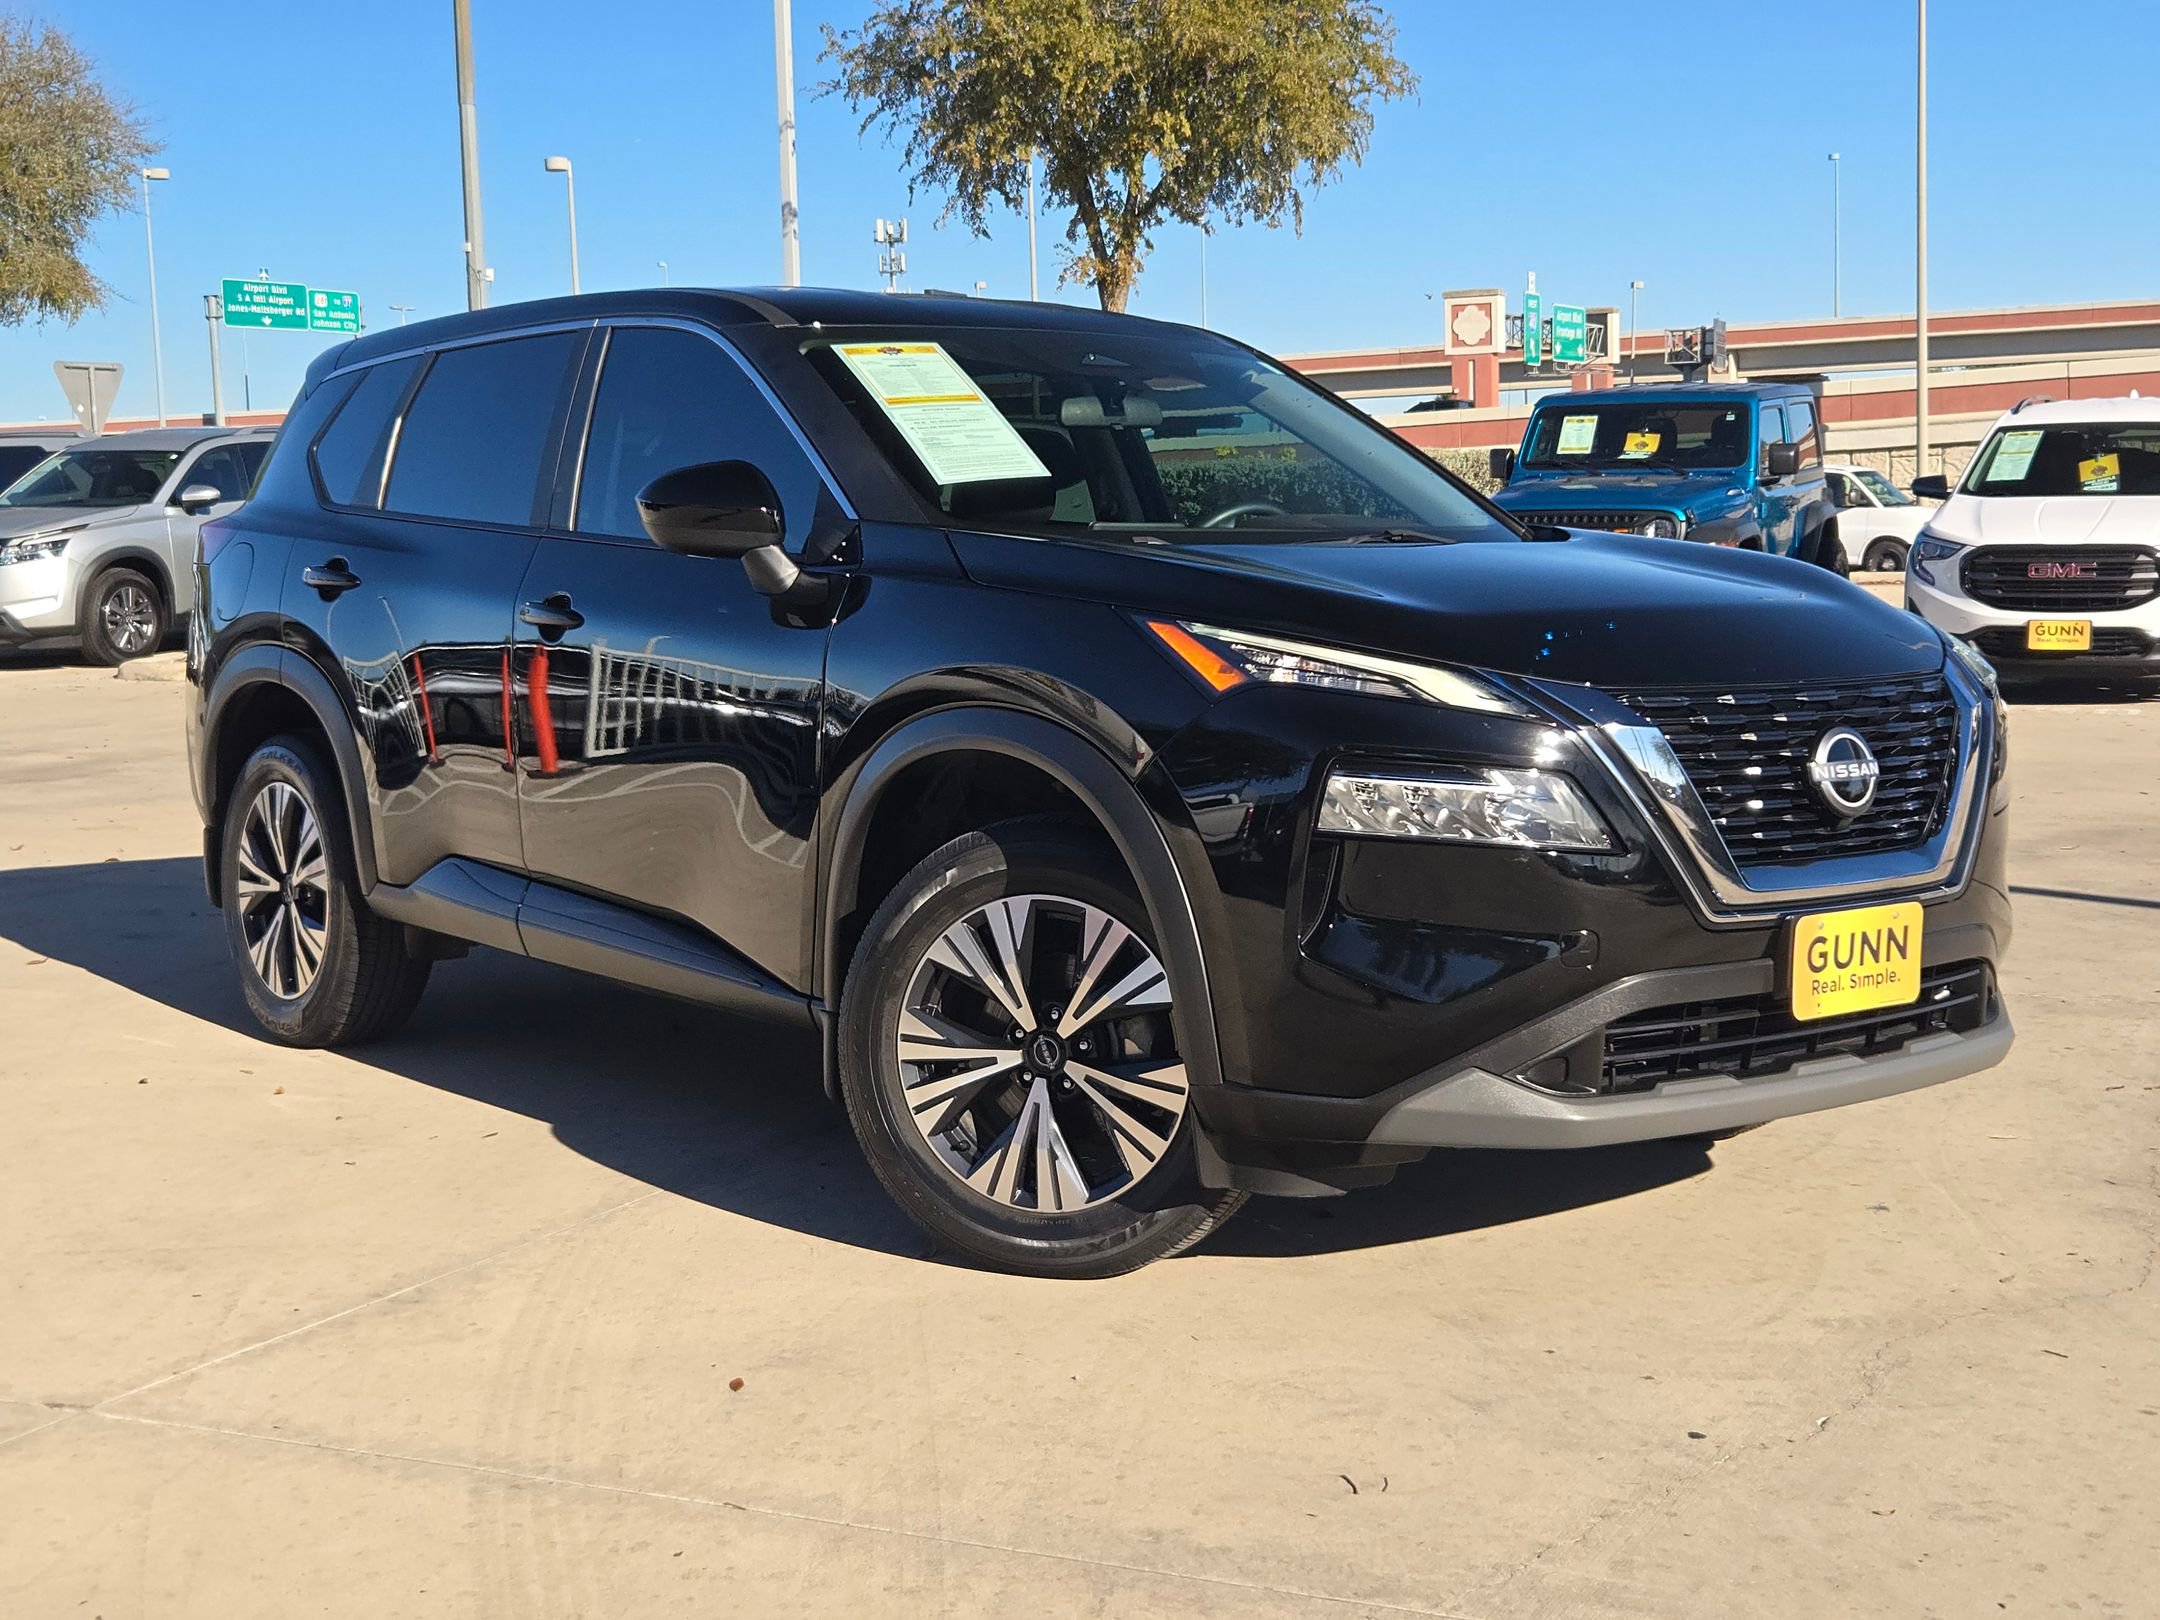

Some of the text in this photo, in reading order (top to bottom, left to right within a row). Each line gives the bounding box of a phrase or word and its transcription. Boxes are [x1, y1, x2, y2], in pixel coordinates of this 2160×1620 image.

[243, 283, 288, 295] Airport Blvd
[245, 294, 251, 302] A
[268, 295, 294, 306] Airport
[295, 307, 306, 316] Rd
[313, 309, 356, 320] San Antonio
[313, 319, 357, 331] Johnson City
[2027, 562, 2096, 579] GMC
[2035, 625, 2084, 636] GUNN
[1814, 761, 1879, 779] NISSAN
[1807, 925, 1909, 973] GUNN
[1812, 968, 1901, 996] Real. Simple.
[1039, 1035, 1055, 1069] NISSAN
